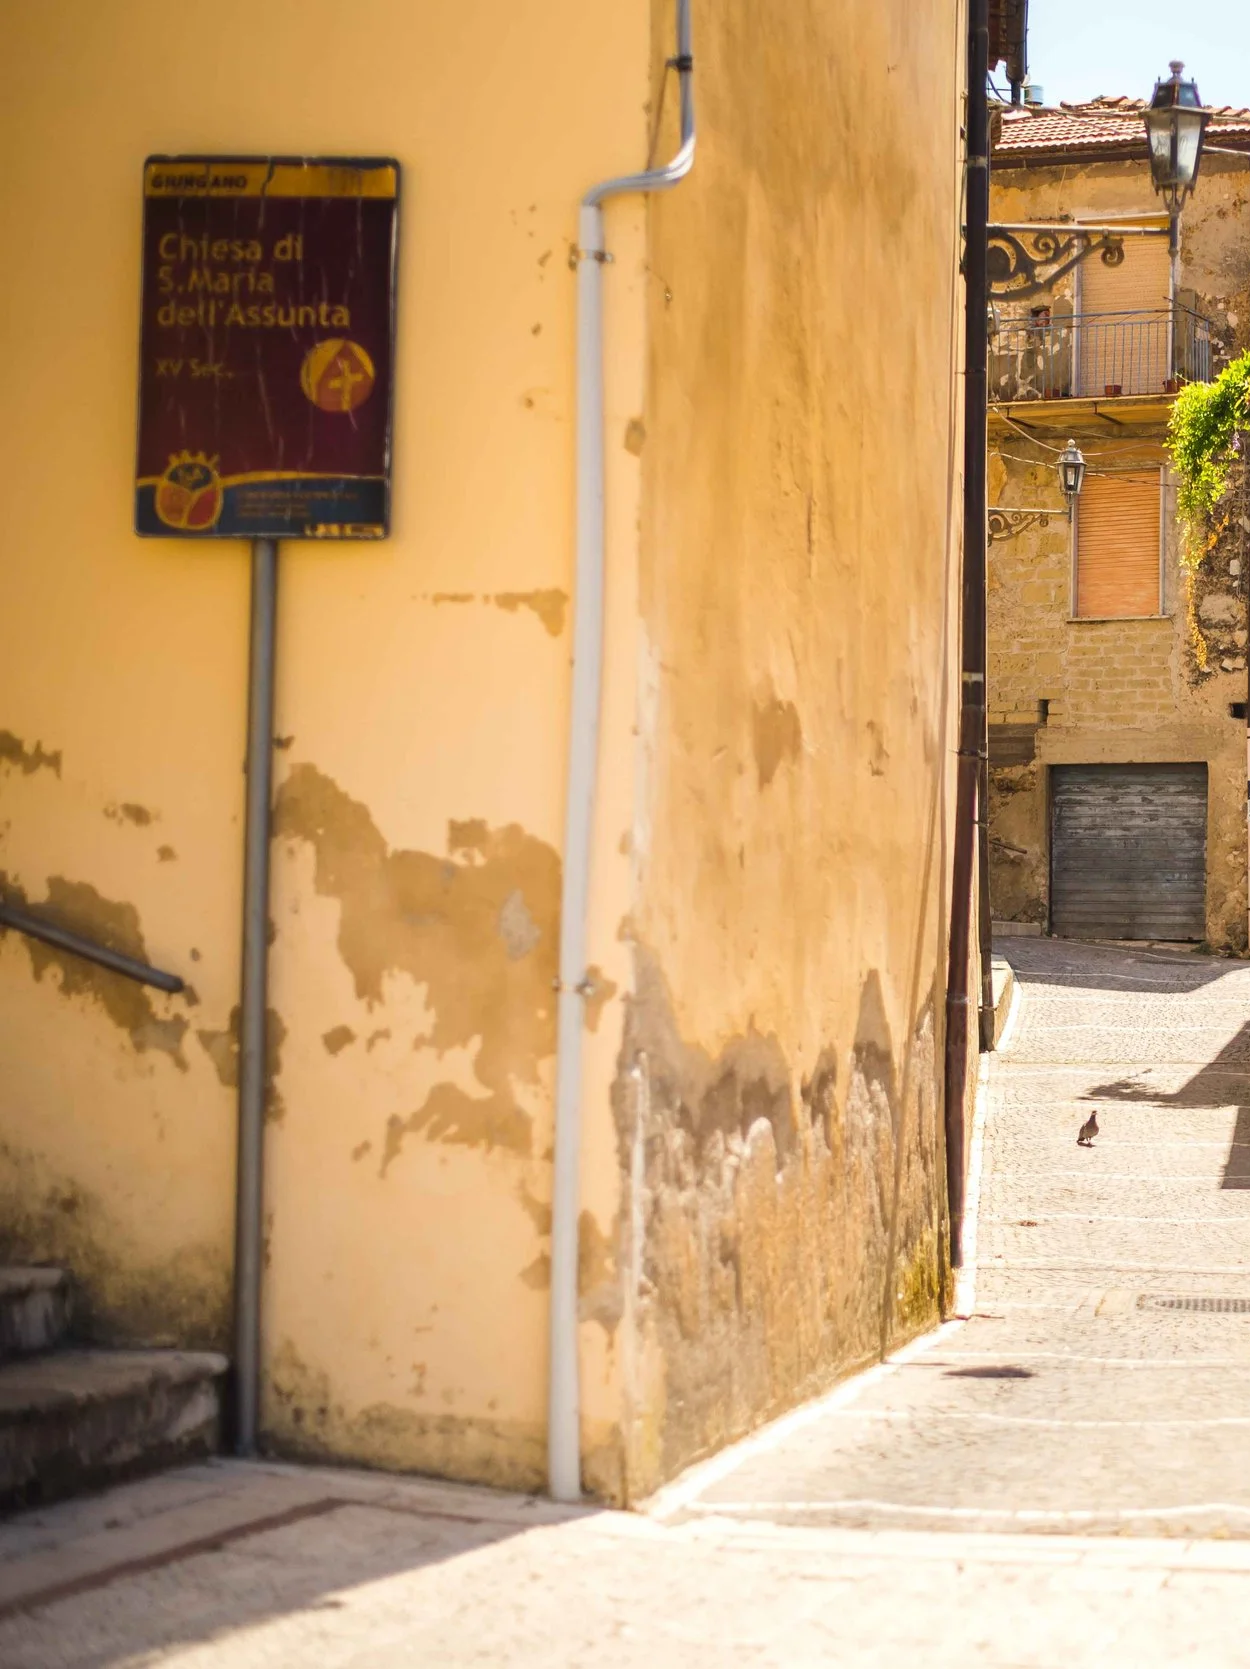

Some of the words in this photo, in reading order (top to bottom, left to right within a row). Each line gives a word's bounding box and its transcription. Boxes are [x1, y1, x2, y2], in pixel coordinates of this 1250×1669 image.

[151, 174, 248, 190] GIUNGANO
[158, 233, 262, 261] Chiesa
[273, 234, 303, 260] di
[157, 300, 350, 327] dell'Assunta
[156, 358, 183, 377] XV
